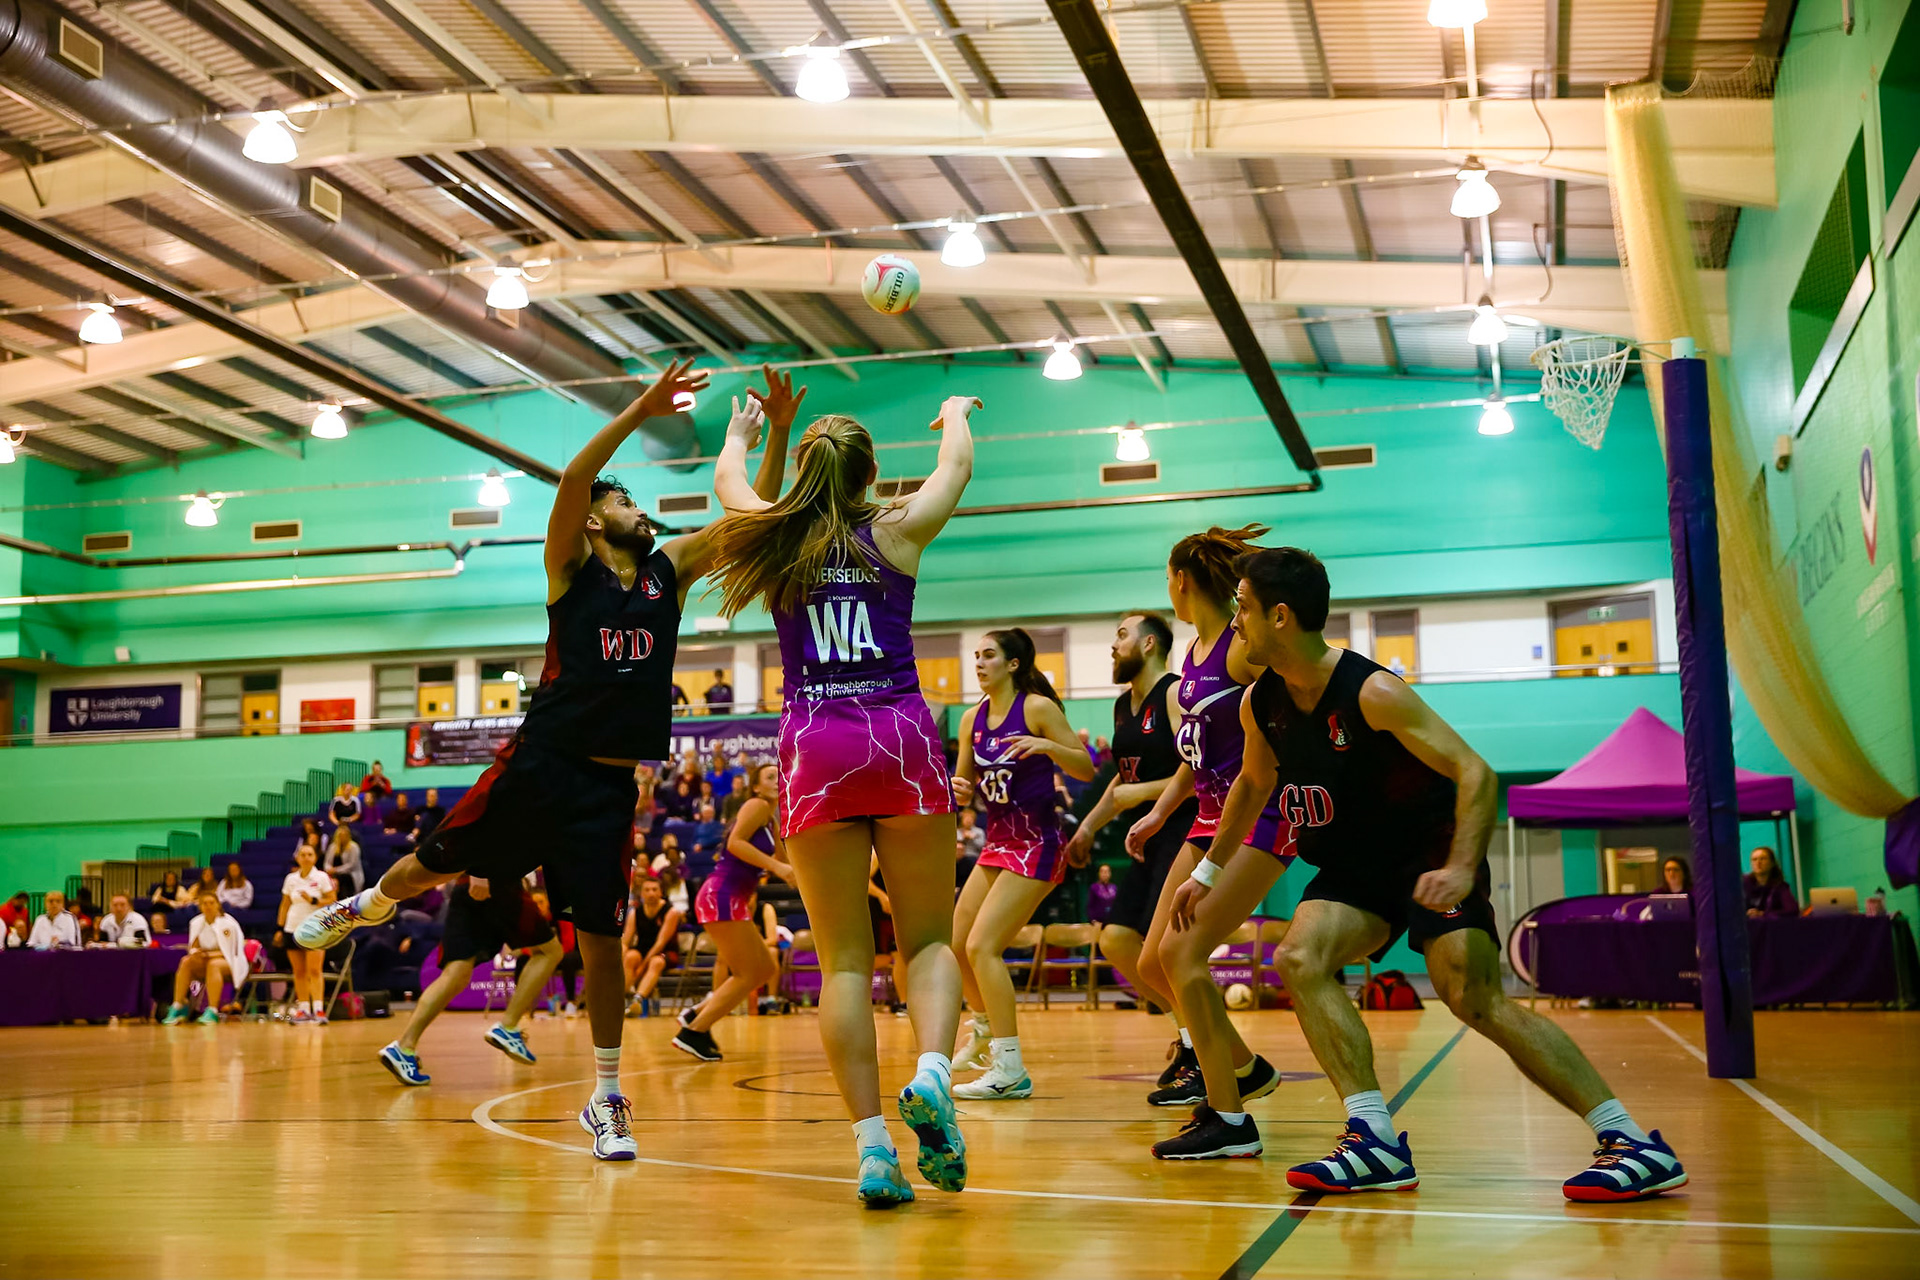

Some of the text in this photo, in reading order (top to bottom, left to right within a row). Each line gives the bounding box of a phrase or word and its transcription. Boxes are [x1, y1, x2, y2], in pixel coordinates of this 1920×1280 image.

[599, 627, 654, 661] WD
[806, 601, 885, 665] WA
[826, 678, 893, 690] Loughborough
[826, 688, 874, 697] University
[91, 694, 164, 710] Loughborough
[91, 708, 142, 724] University
[980, 767, 1013, 804] GS
[1278, 783, 1334, 827] GD
